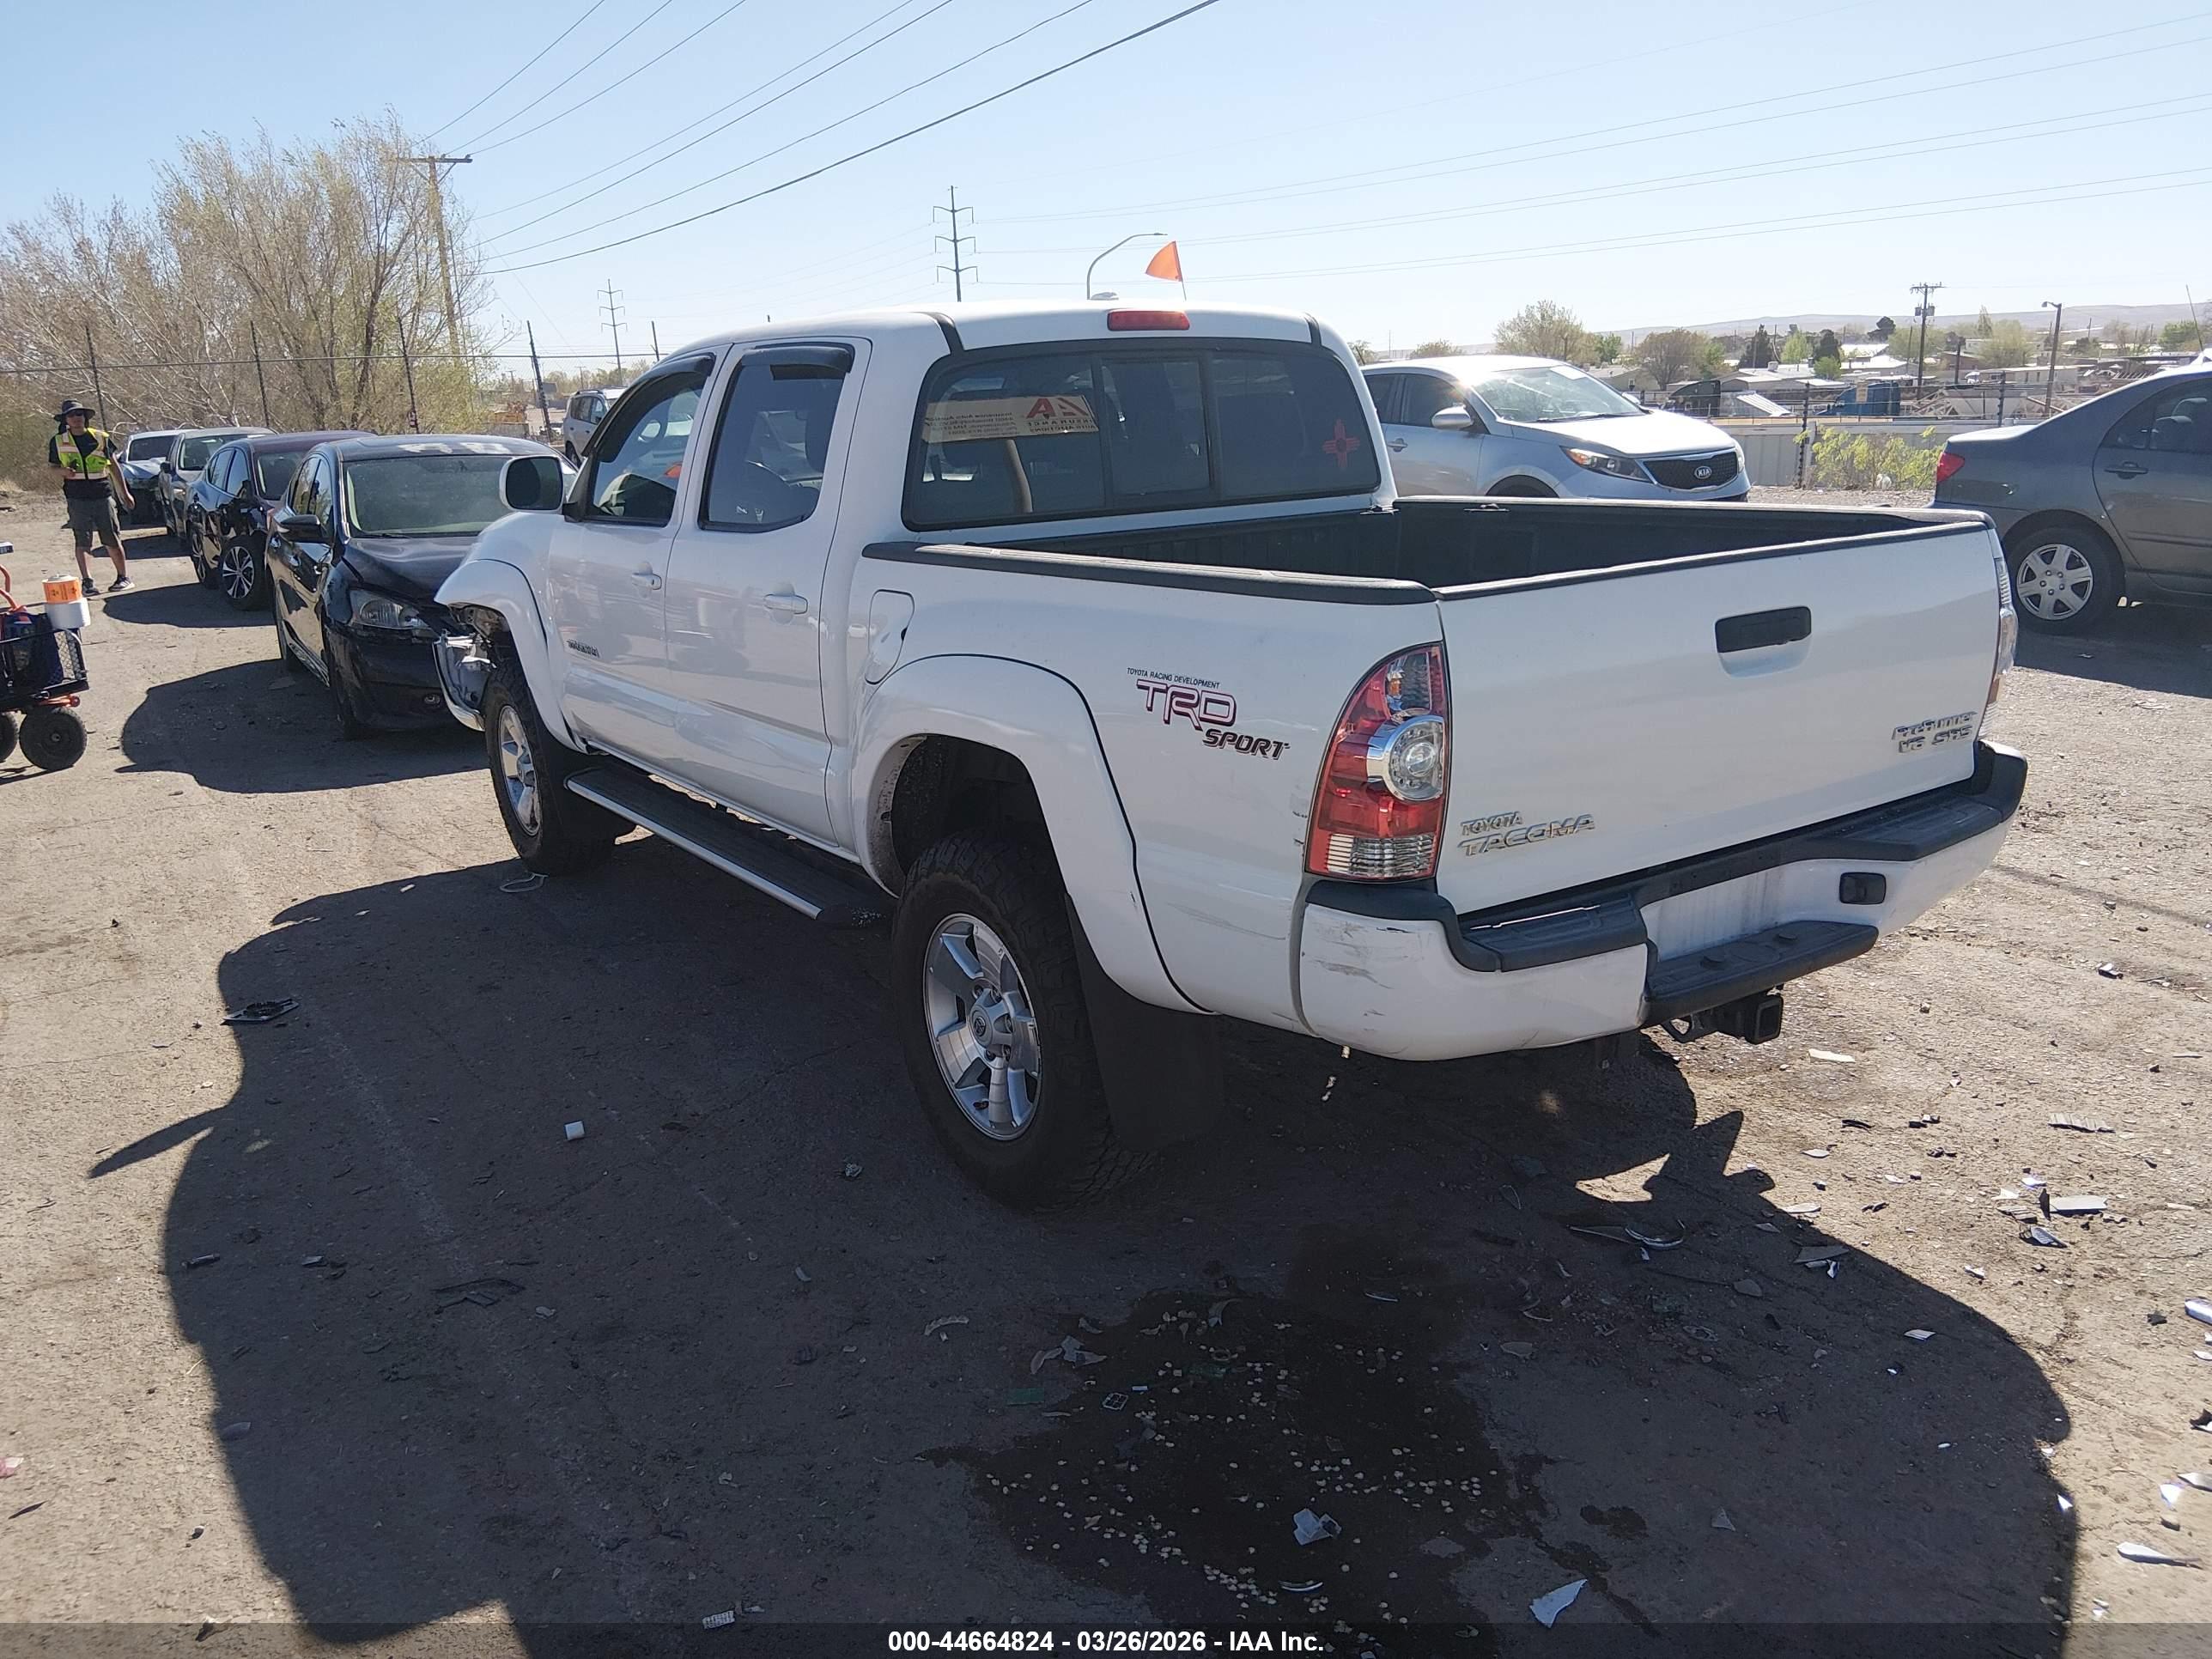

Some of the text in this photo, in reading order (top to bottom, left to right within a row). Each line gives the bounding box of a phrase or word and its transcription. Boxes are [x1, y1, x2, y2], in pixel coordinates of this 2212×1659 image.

[1127, 667, 1220, 690] TOYOTA RACING DEVELOPMENT
[1136, 678, 1237, 732] TRD
[1203, 728, 1291, 761] SPORT
[1457, 814, 1595, 856] TACOMA
[1461, 811, 1524, 836] TOYOTA
